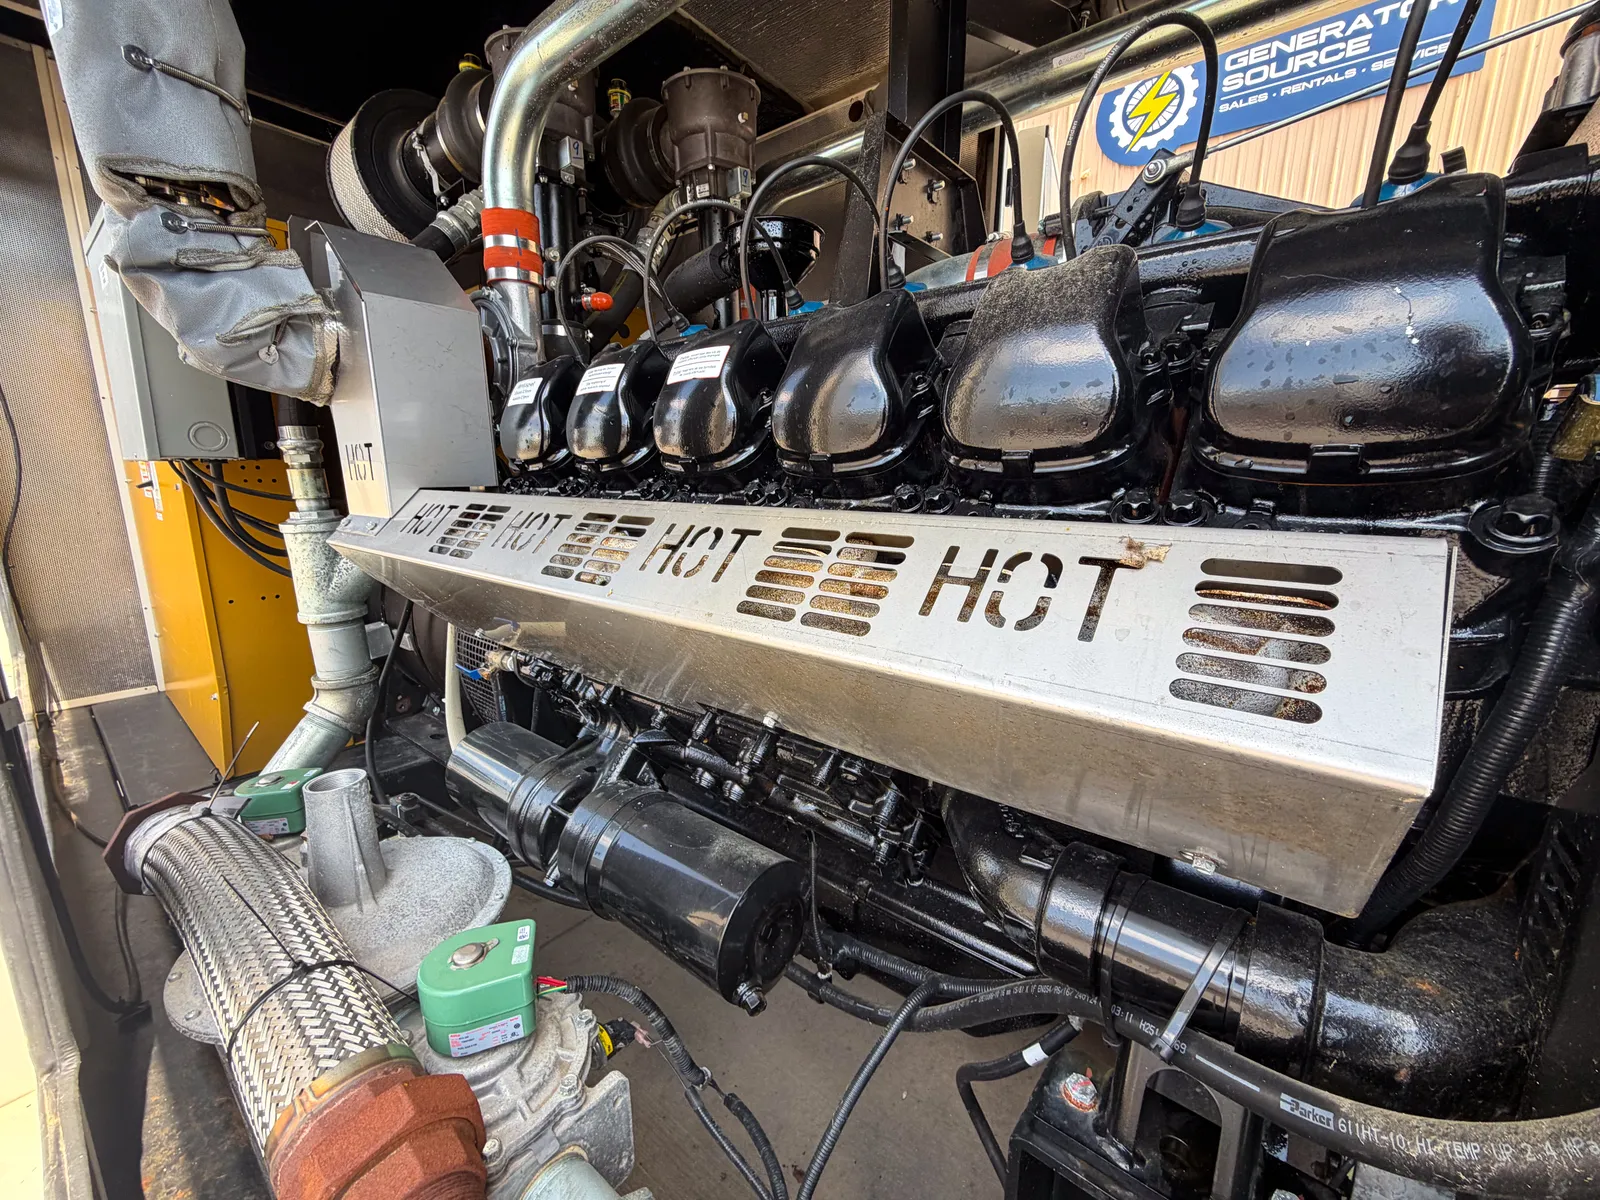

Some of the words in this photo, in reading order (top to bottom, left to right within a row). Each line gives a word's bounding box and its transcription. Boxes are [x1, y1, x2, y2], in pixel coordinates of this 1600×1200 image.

[1219, 92, 1268, 112] SALES
[1280, 68, 1357, 96] RENTALS
[1371, 42, 1451, 72] SEVICE
[1222, 33, 1372, 92] SOURCE
[573, 141, 579, 155] 9
[345, 443, 374, 480] HOT
[400, 503, 459, 536] HOT
[491, 510, 572, 554] HOT
[639, 523, 762, 582] HOT
[918, 545, 1143, 642] HOT
[1284, 1097, 1333, 1128] Parker
